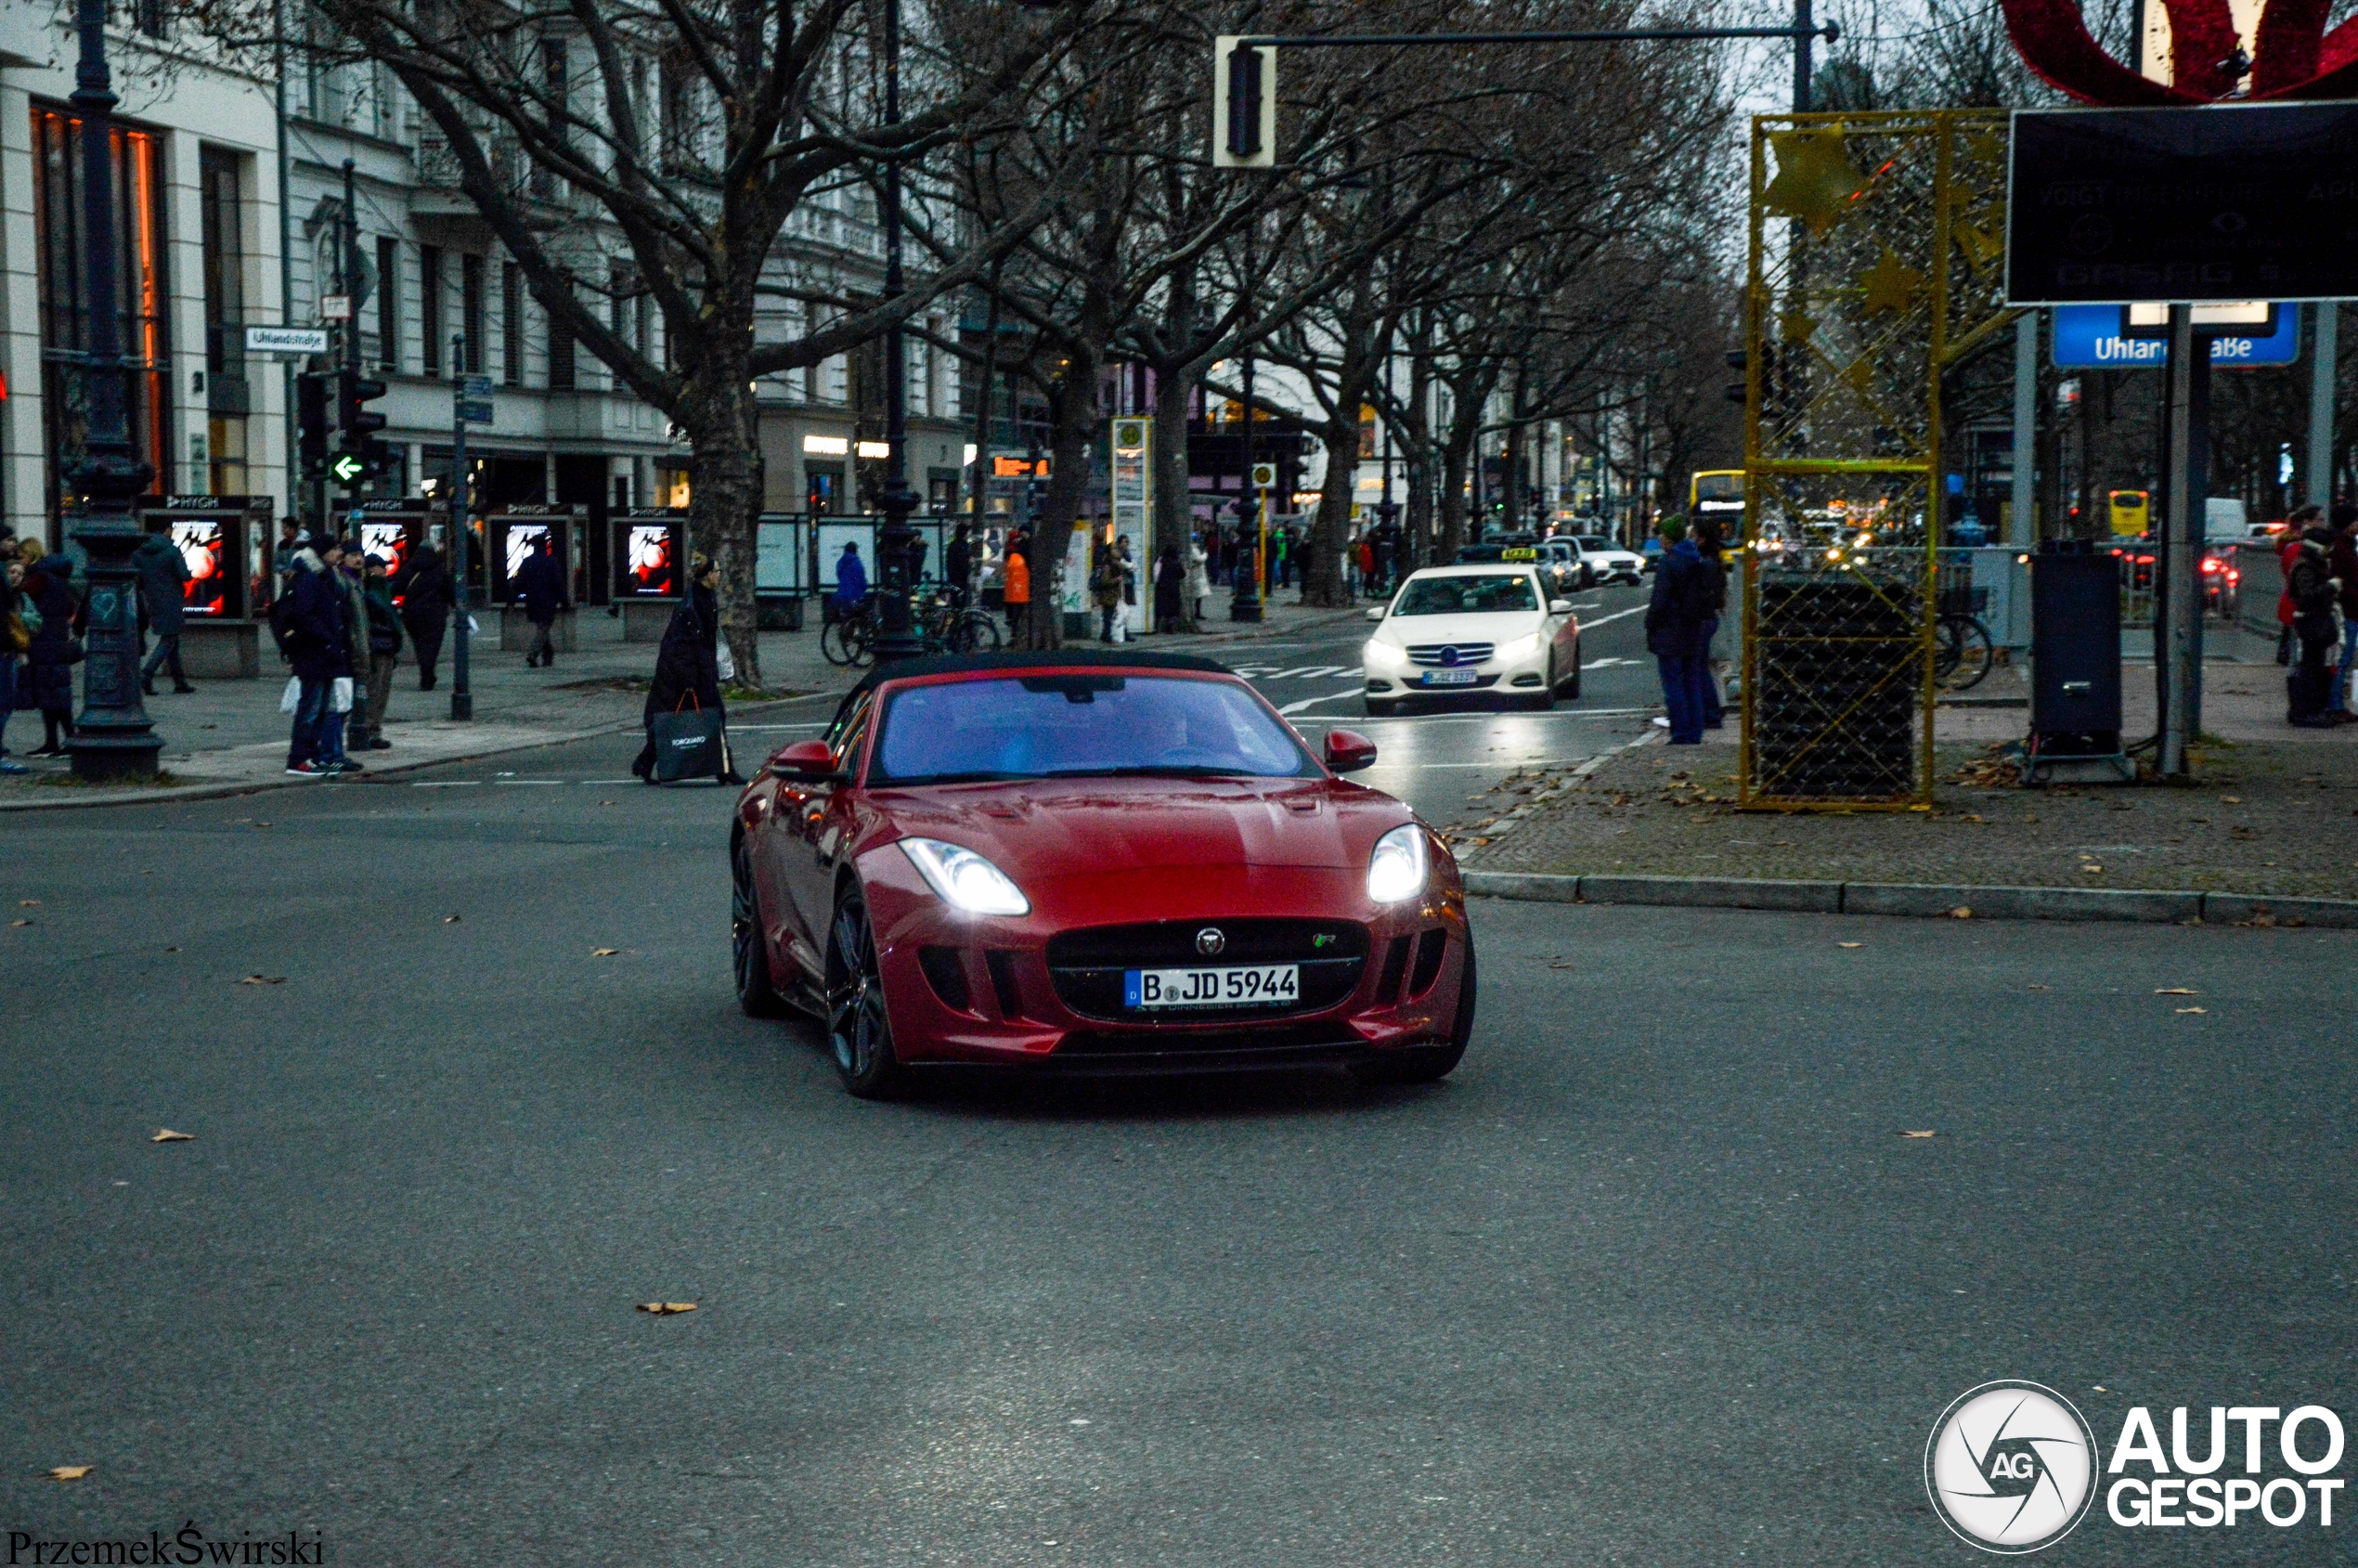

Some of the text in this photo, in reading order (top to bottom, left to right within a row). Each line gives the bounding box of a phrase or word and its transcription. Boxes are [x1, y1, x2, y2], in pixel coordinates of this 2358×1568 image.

[1130, 969, 1296, 1001] D B JD 5944
